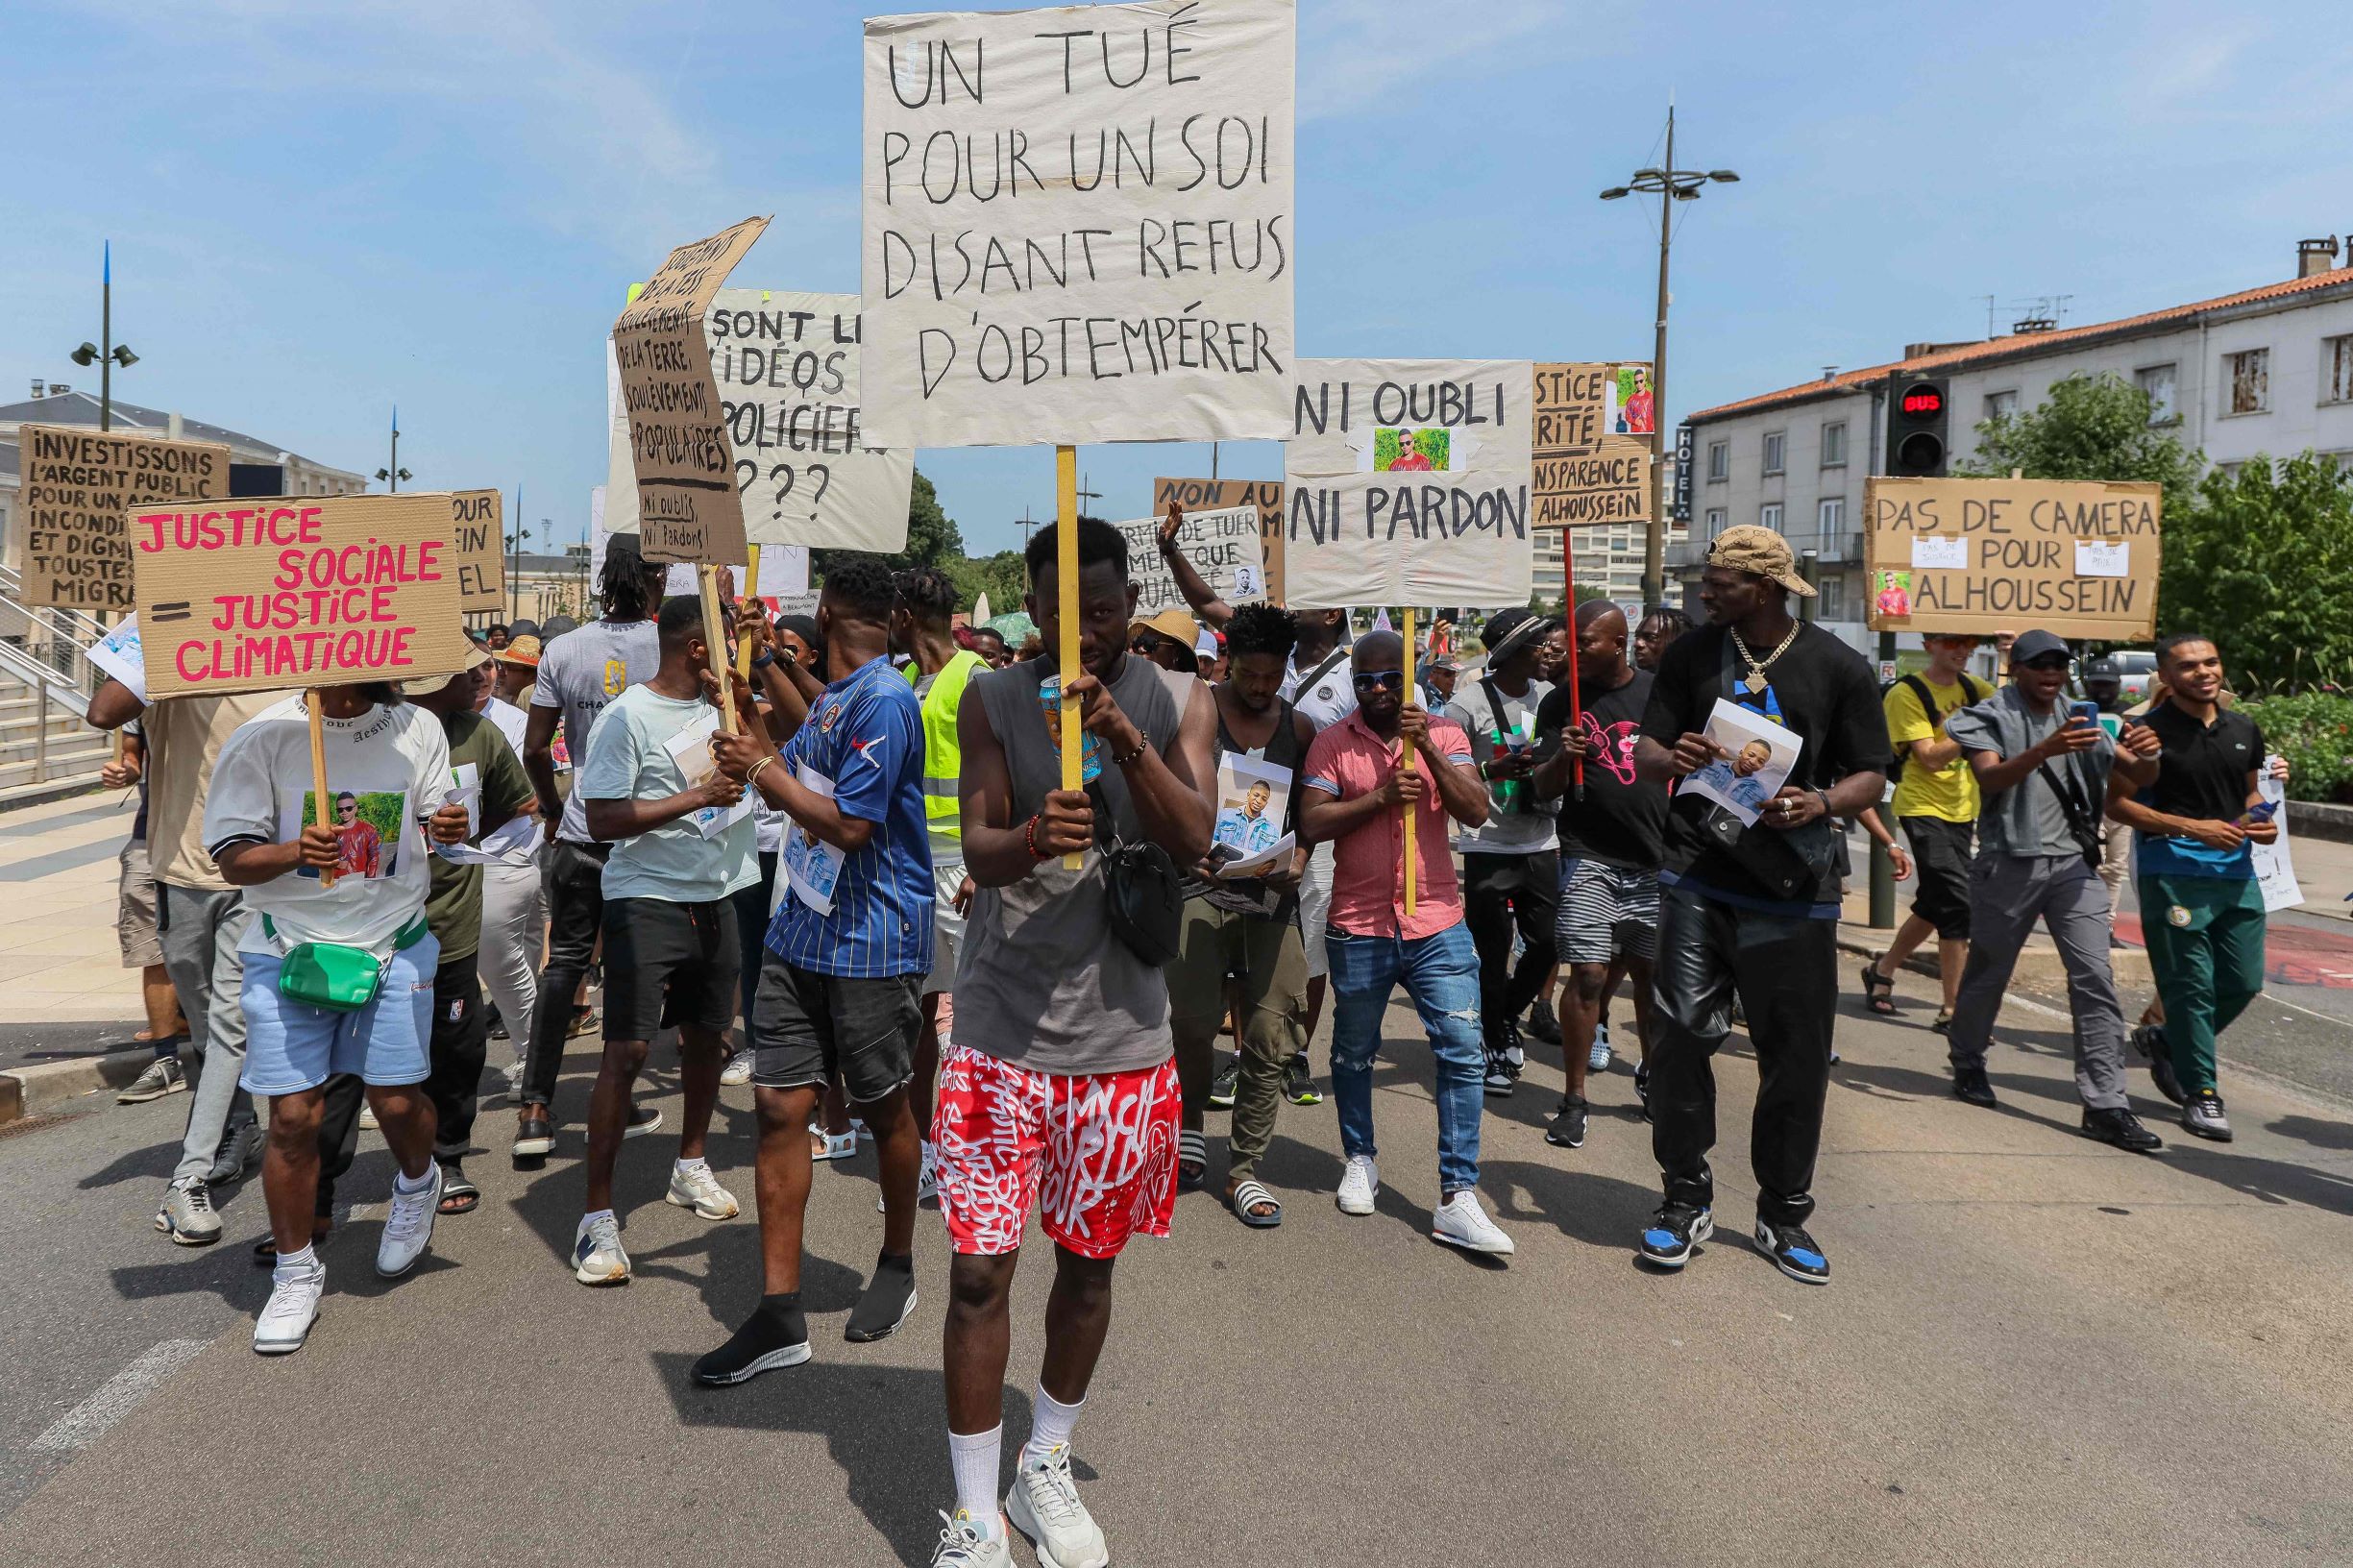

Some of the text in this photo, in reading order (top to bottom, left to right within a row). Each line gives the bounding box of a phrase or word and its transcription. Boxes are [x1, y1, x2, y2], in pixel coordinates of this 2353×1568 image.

[889, 2, 1201, 109] UN TUÉ
[884, 113, 1267, 206] POUR UN SOI
[884, 215, 1286, 301] DISANT REFUS
[712, 309, 815, 345] SONT
[620, 345, 630, 371] DE
[631, 339, 644, 367] LA
[919, 301, 1283, 400] D'OBTEMPÉRER
[1295, 380, 1505, 435] NI OUBLI
[1904, 395, 1939, 411] BUS
[30, 461, 128, 488] L'ARGENT
[1532, 457, 1640, 491] NSPARENCE
[1679, 432, 1691, 504] HOTEL
[28, 486, 87, 508] POUR
[92, 493, 121, 510] UN
[1159, 481, 1279, 508] NON AU
[1182, 519, 1206, 542] DE
[1211, 513, 1258, 538] TUER
[1289, 484, 1527, 546] NI PARDON
[1876, 499, 2157, 535] PAS DE CAMERA
[29, 531, 60, 551] ET
[1195, 543, 1239, 567] QUE
[1981, 539, 2061, 569] POUR
[458, 564, 497, 596] EL
[1916, 578, 2136, 613] ALHOUSSEIN
[577, 700, 611, 709] CHA
[323, 720, 355, 728] ove
